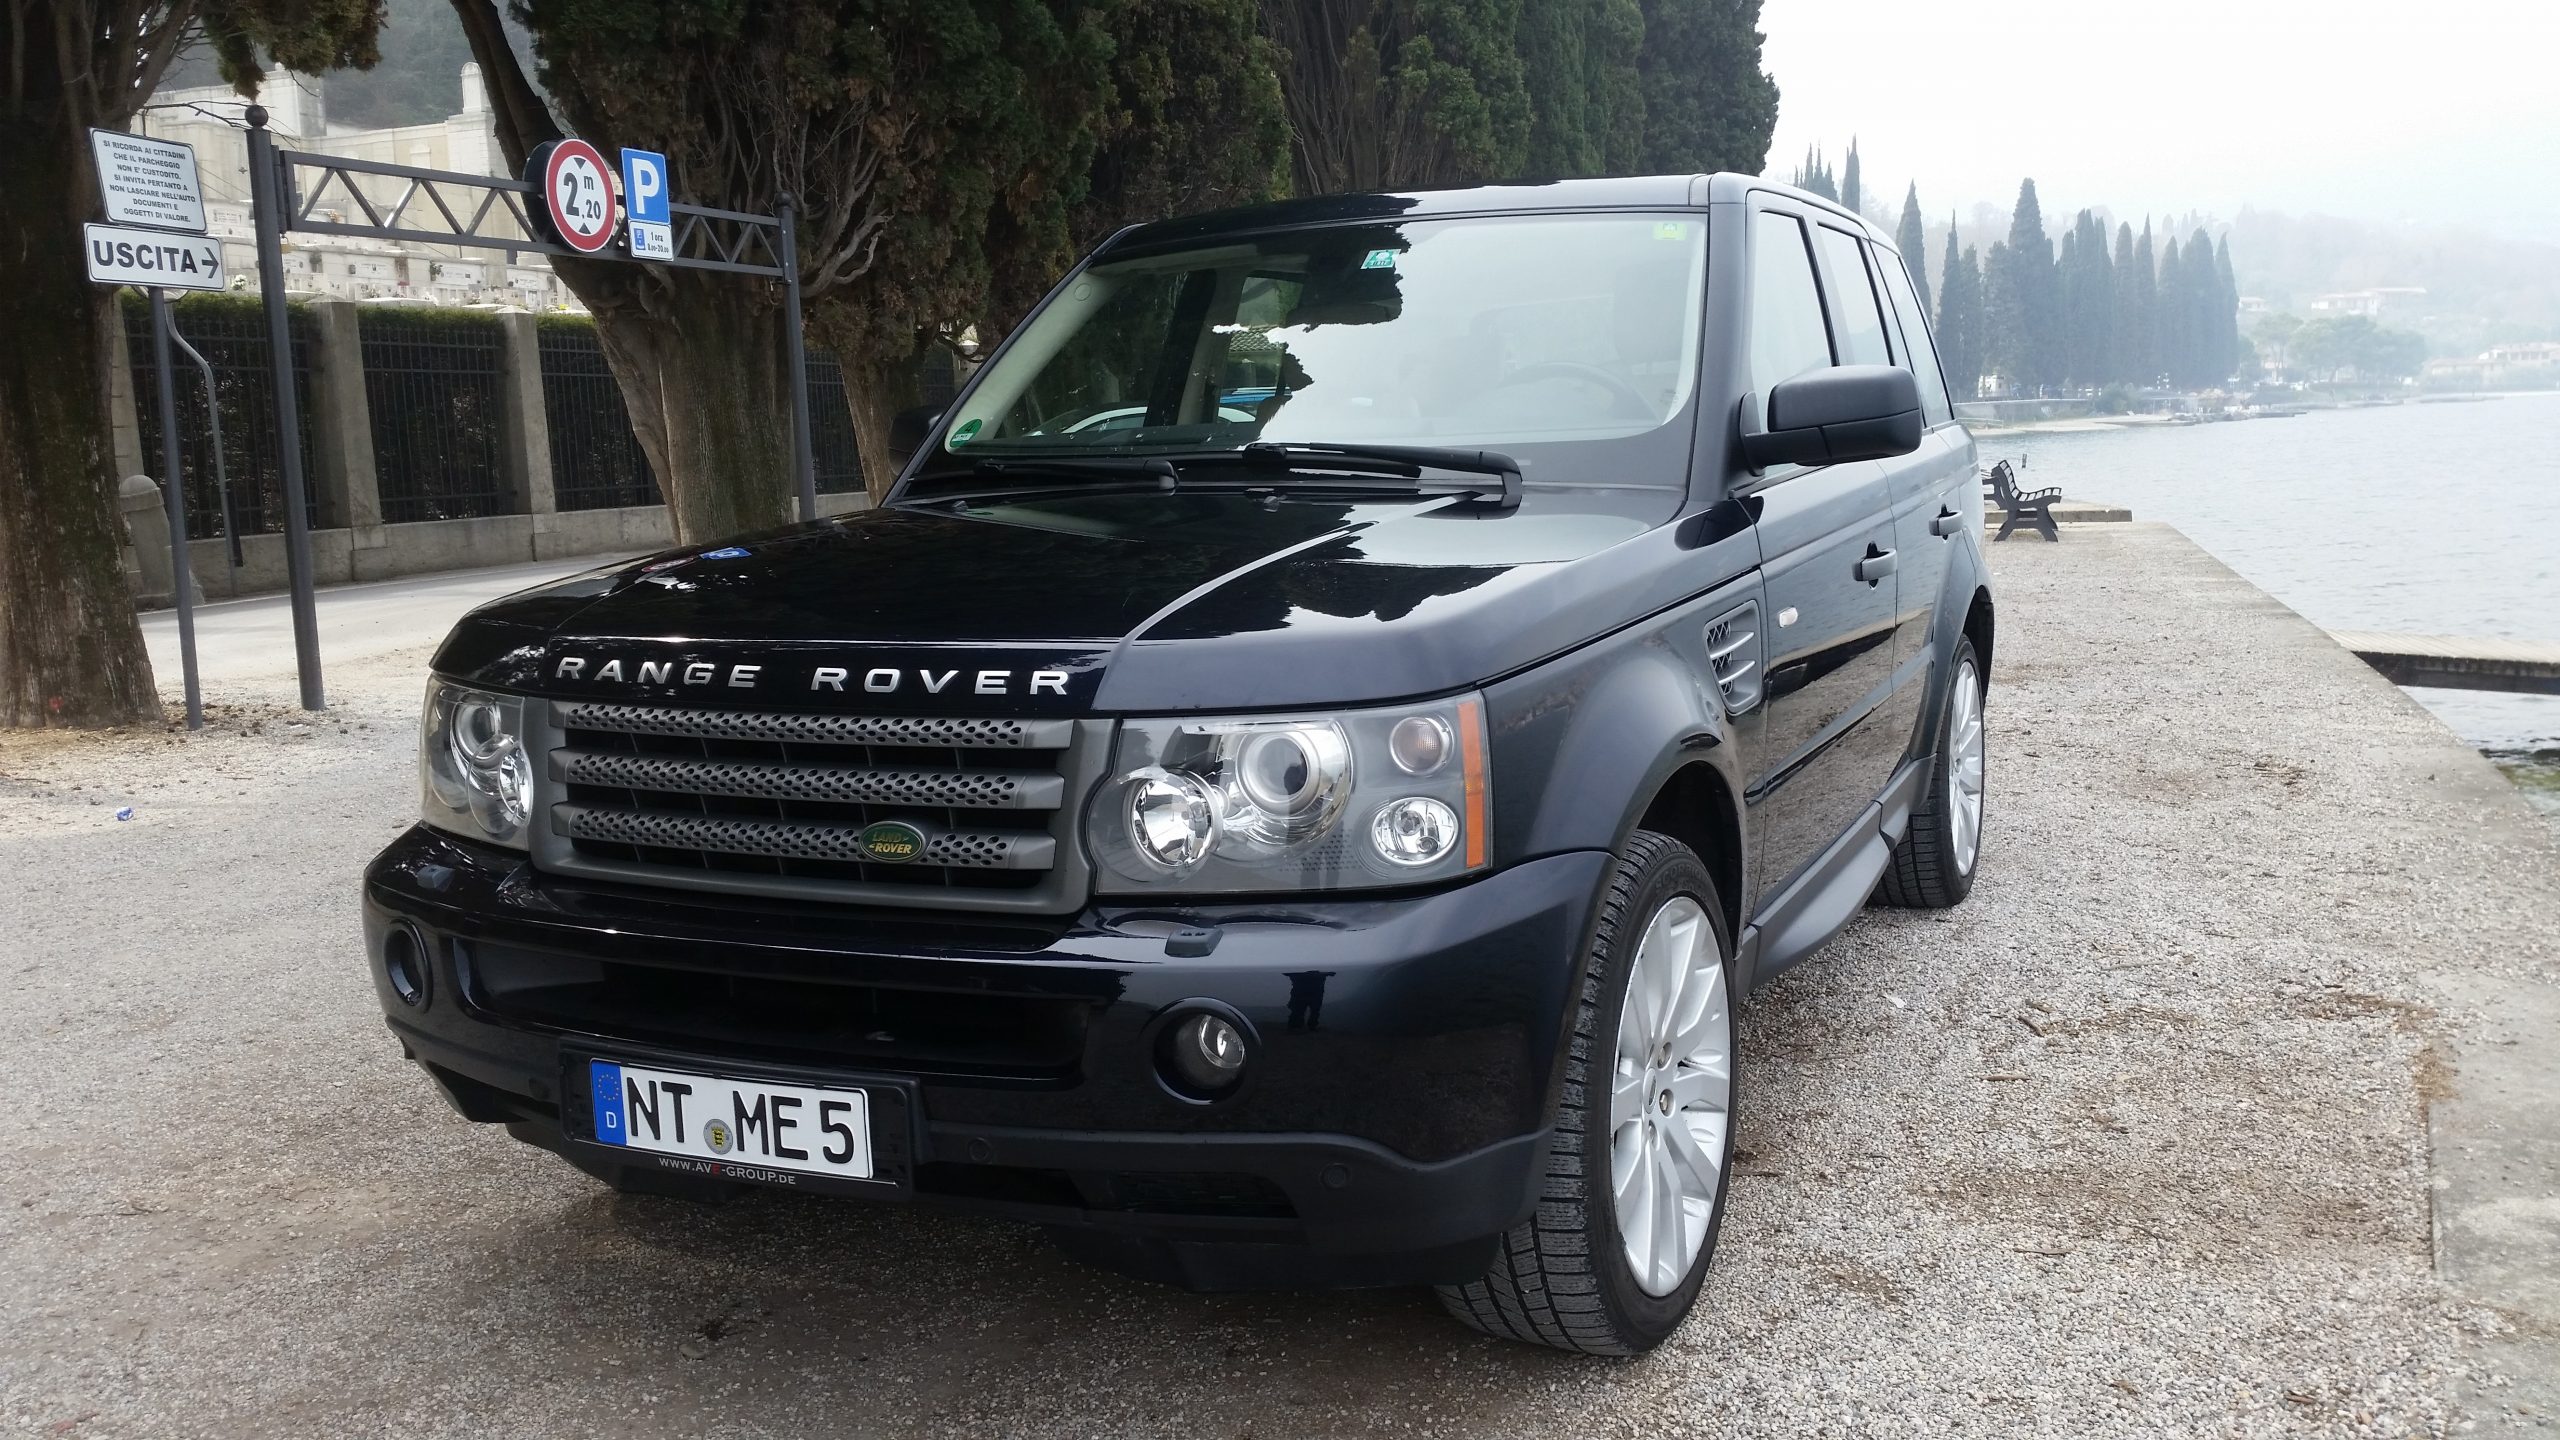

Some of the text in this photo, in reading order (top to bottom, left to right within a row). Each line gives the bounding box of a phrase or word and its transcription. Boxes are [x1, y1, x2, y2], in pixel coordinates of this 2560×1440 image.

[103, 140, 111, 148] SI
[112, 141, 143, 153] RICORDA
[153, 148, 186, 160] CITTADINI
[113, 152, 128, 161] CHE
[138, 156, 181, 169] PARCHEGGIO
[116, 164, 132, 172] NON
[142, 167, 182, 180] CUSTODITO.
[122, 175, 146, 185] INVITA
[147, 179, 182, 190] PERTANTO
[584, 175, 594, 191] m
[632, 158, 660, 215] P
[109, 184, 196, 203] NON LASCIARE NELL'AUTO
[132, 198, 172, 209] DOCUMENTI
[123, 207, 191, 222] OGGETTI DI VALORE.
[93, 239, 199, 274] USCITA
[555, 656, 1070, 696] RANGE ROVER
[872, 831, 902, 843] LAND
[875, 843, 912, 854] ROVER
[605, 1111, 617, 1129] D
[626, 1076, 693, 1143] NT
[732, 1090, 808, 1161] ME
[819, 1100, 855, 1164] 5
